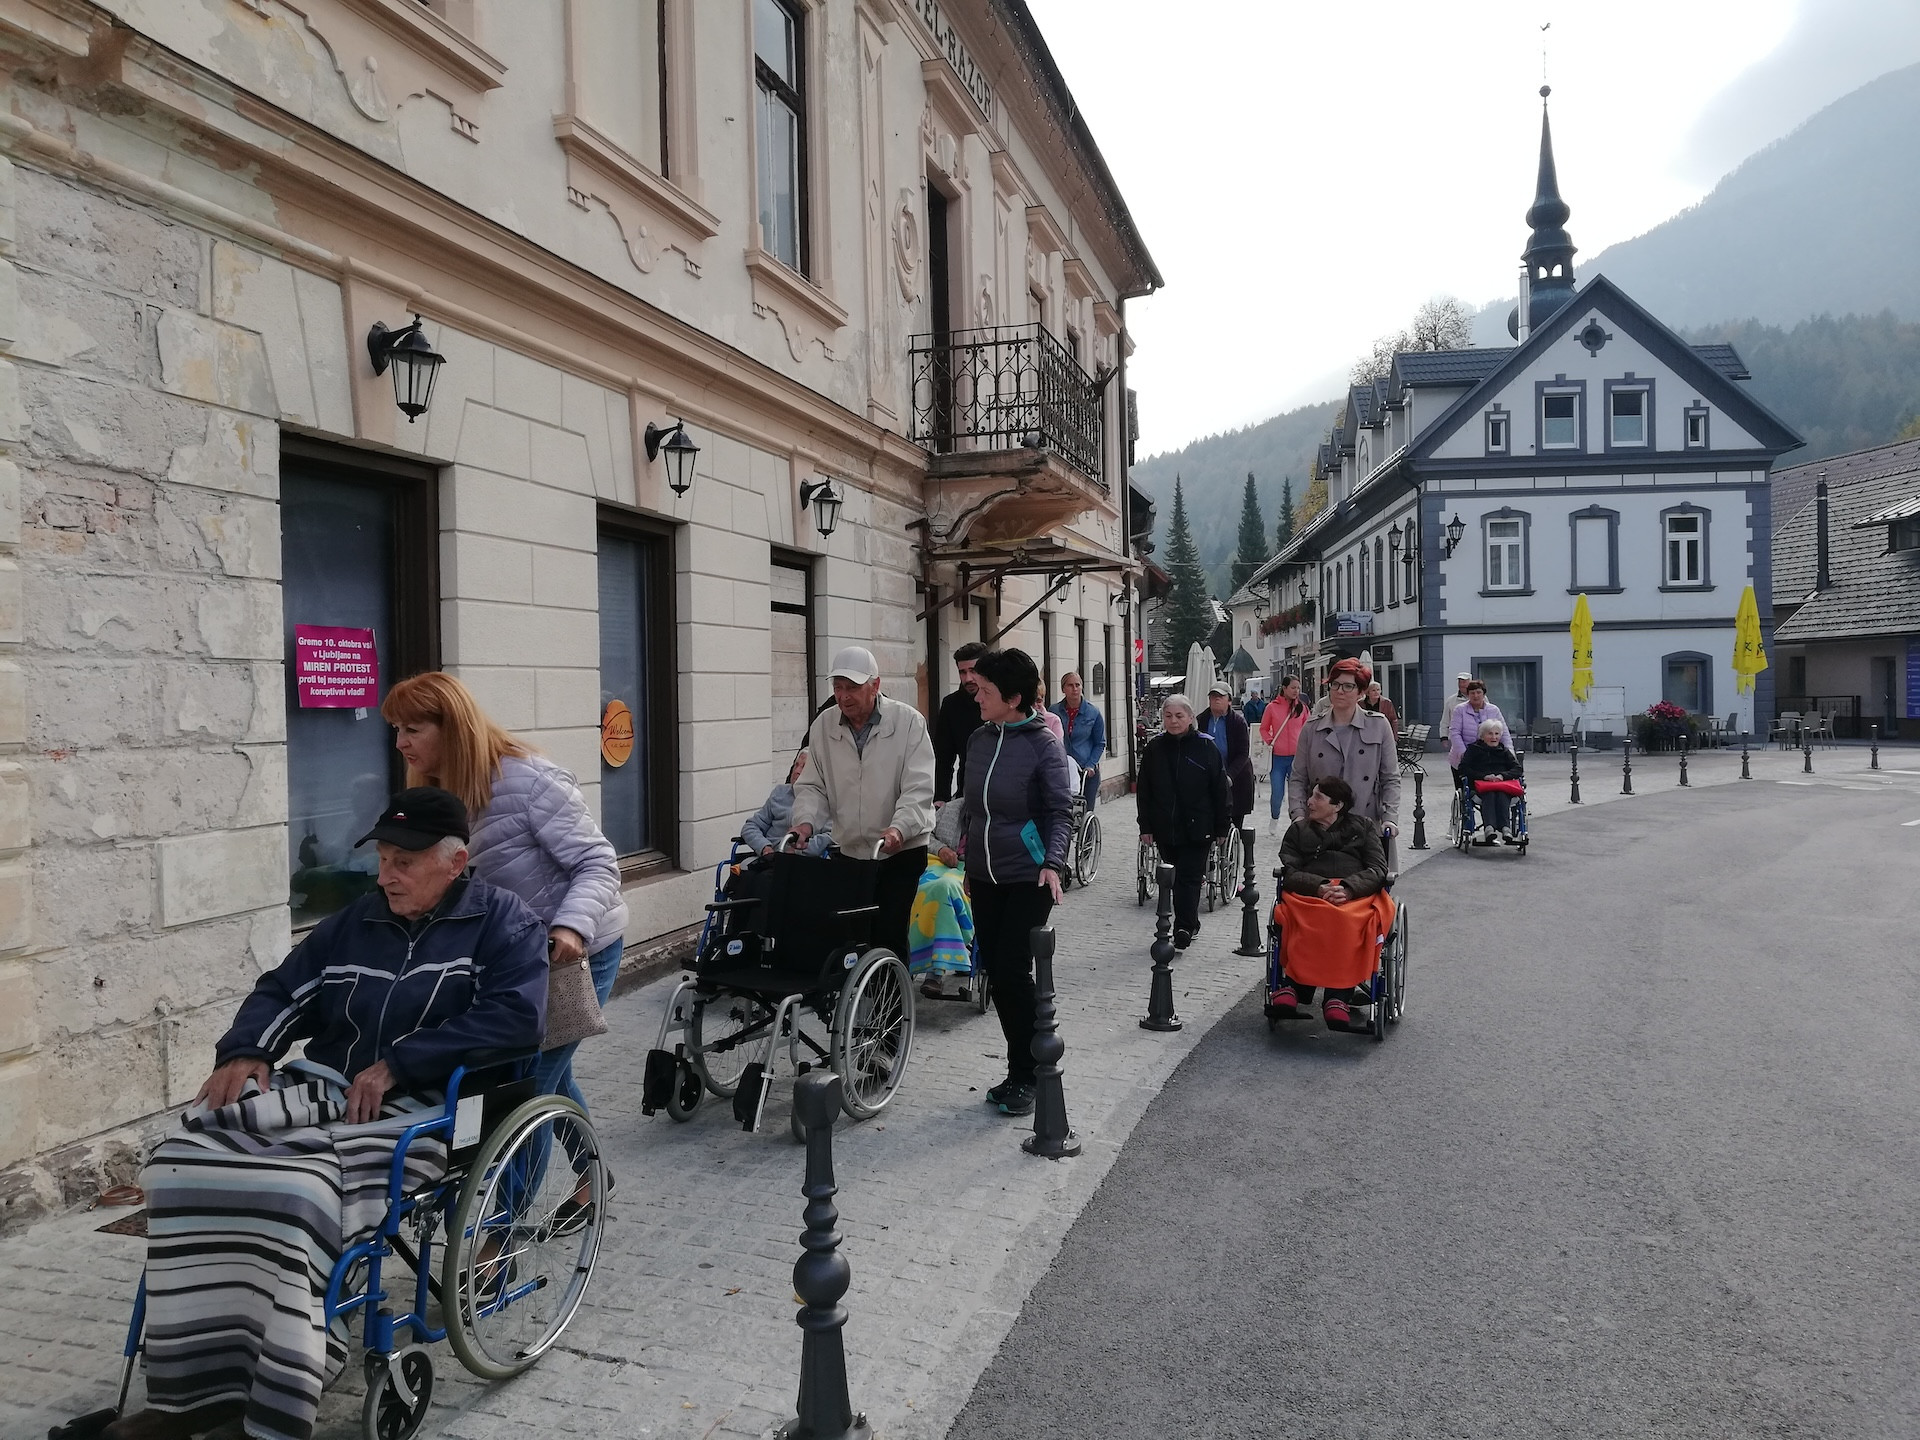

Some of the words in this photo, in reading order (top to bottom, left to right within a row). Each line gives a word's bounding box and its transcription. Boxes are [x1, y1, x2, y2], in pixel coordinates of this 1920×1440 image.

[947, 25, 992, 120] RAZOR
[298, 637, 323, 646] Gremo
[324, 639, 336, 647] 10.
[338, 640, 362, 648] oktobra
[362, 641, 372, 649] vsi
[319, 650, 352, 660] Ljubljano
[303, 662, 331, 672] MIREN
[333, 663, 371, 673] PROTEST
[299, 675, 317, 685] proti
[317, 676, 326, 685] tej
[328, 676, 368, 686] nesposobni
[310, 687, 346, 697] koruptivni
[347, 688, 365, 696] vladi!
